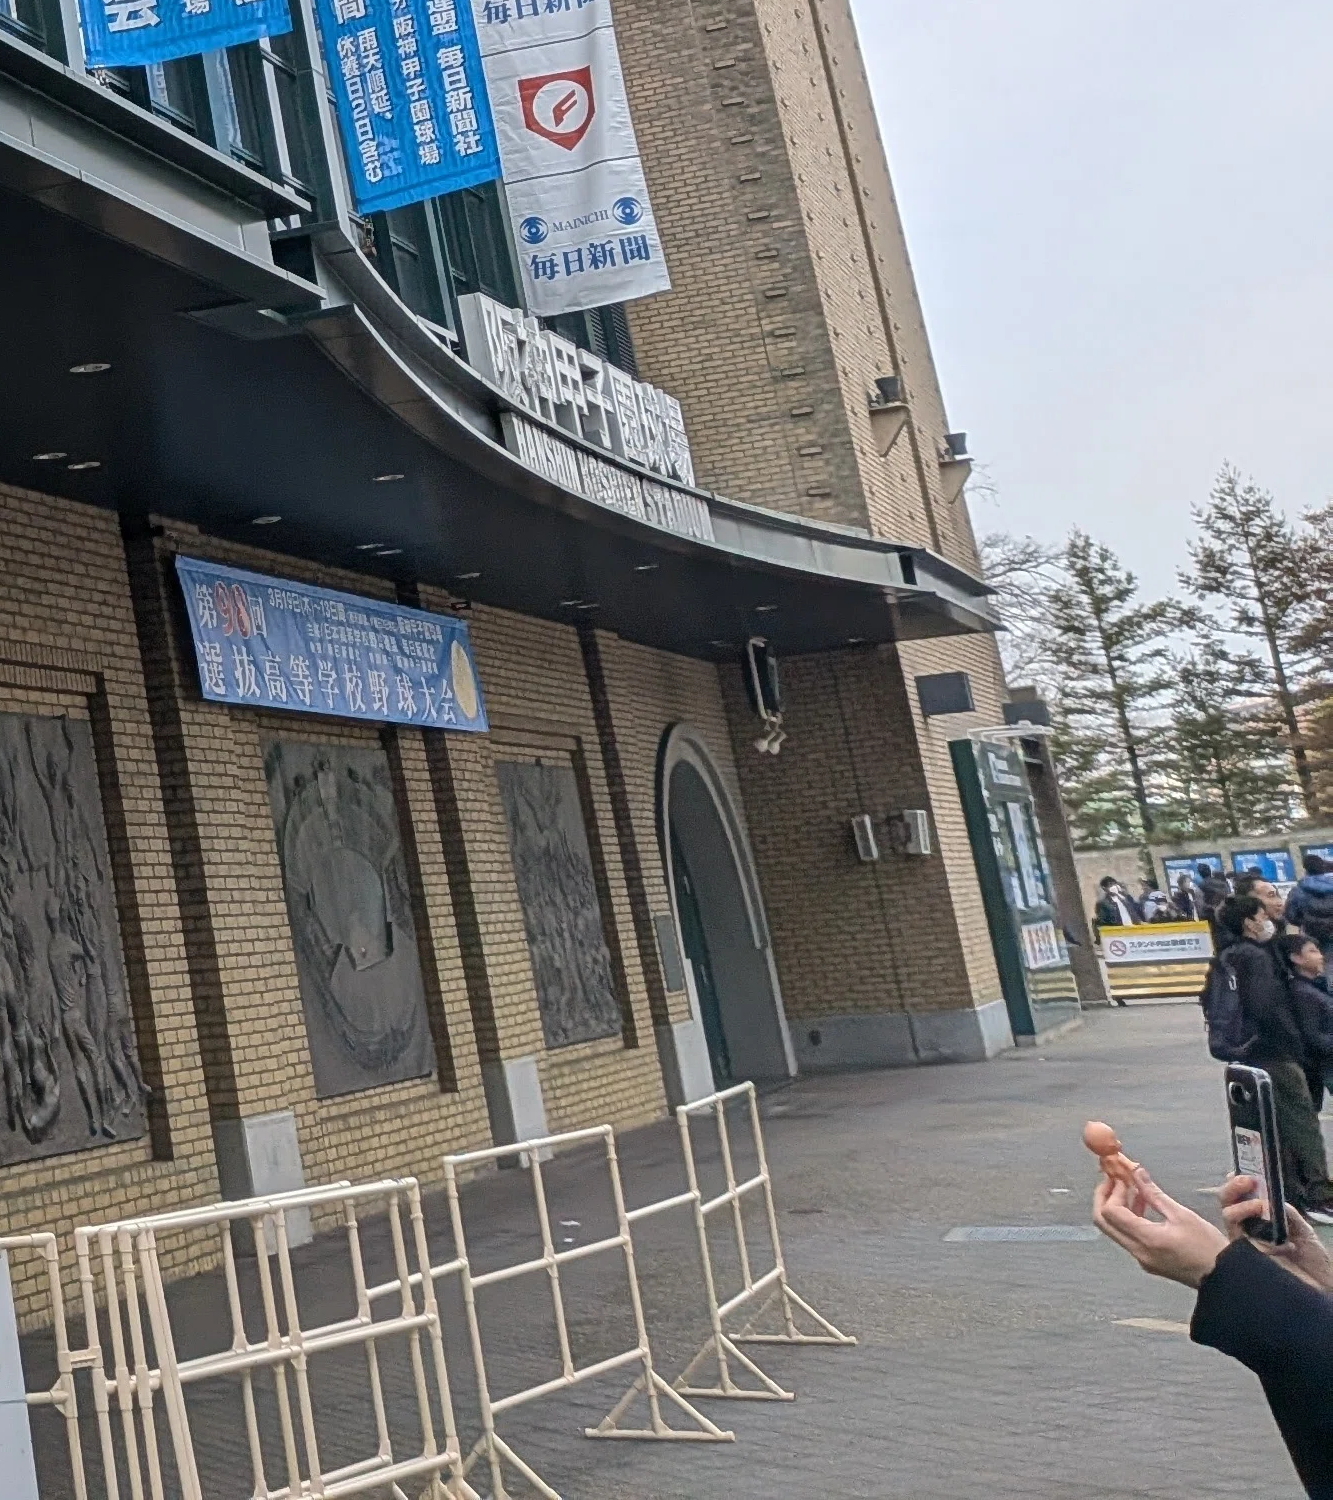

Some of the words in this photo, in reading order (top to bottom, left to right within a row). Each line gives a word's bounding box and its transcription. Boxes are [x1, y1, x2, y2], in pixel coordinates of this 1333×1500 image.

[392, 14, 442, 166] 阪神甲子園球場
[436, 43, 484, 157] 毎日新聞社
[529, 233, 652, 281] 毎日新聞
[552, 208, 611, 234] MAINICHI
[195, 580, 268, 640] 第98回
[196, 641, 458, 725] 選抜高等学校野球大会
